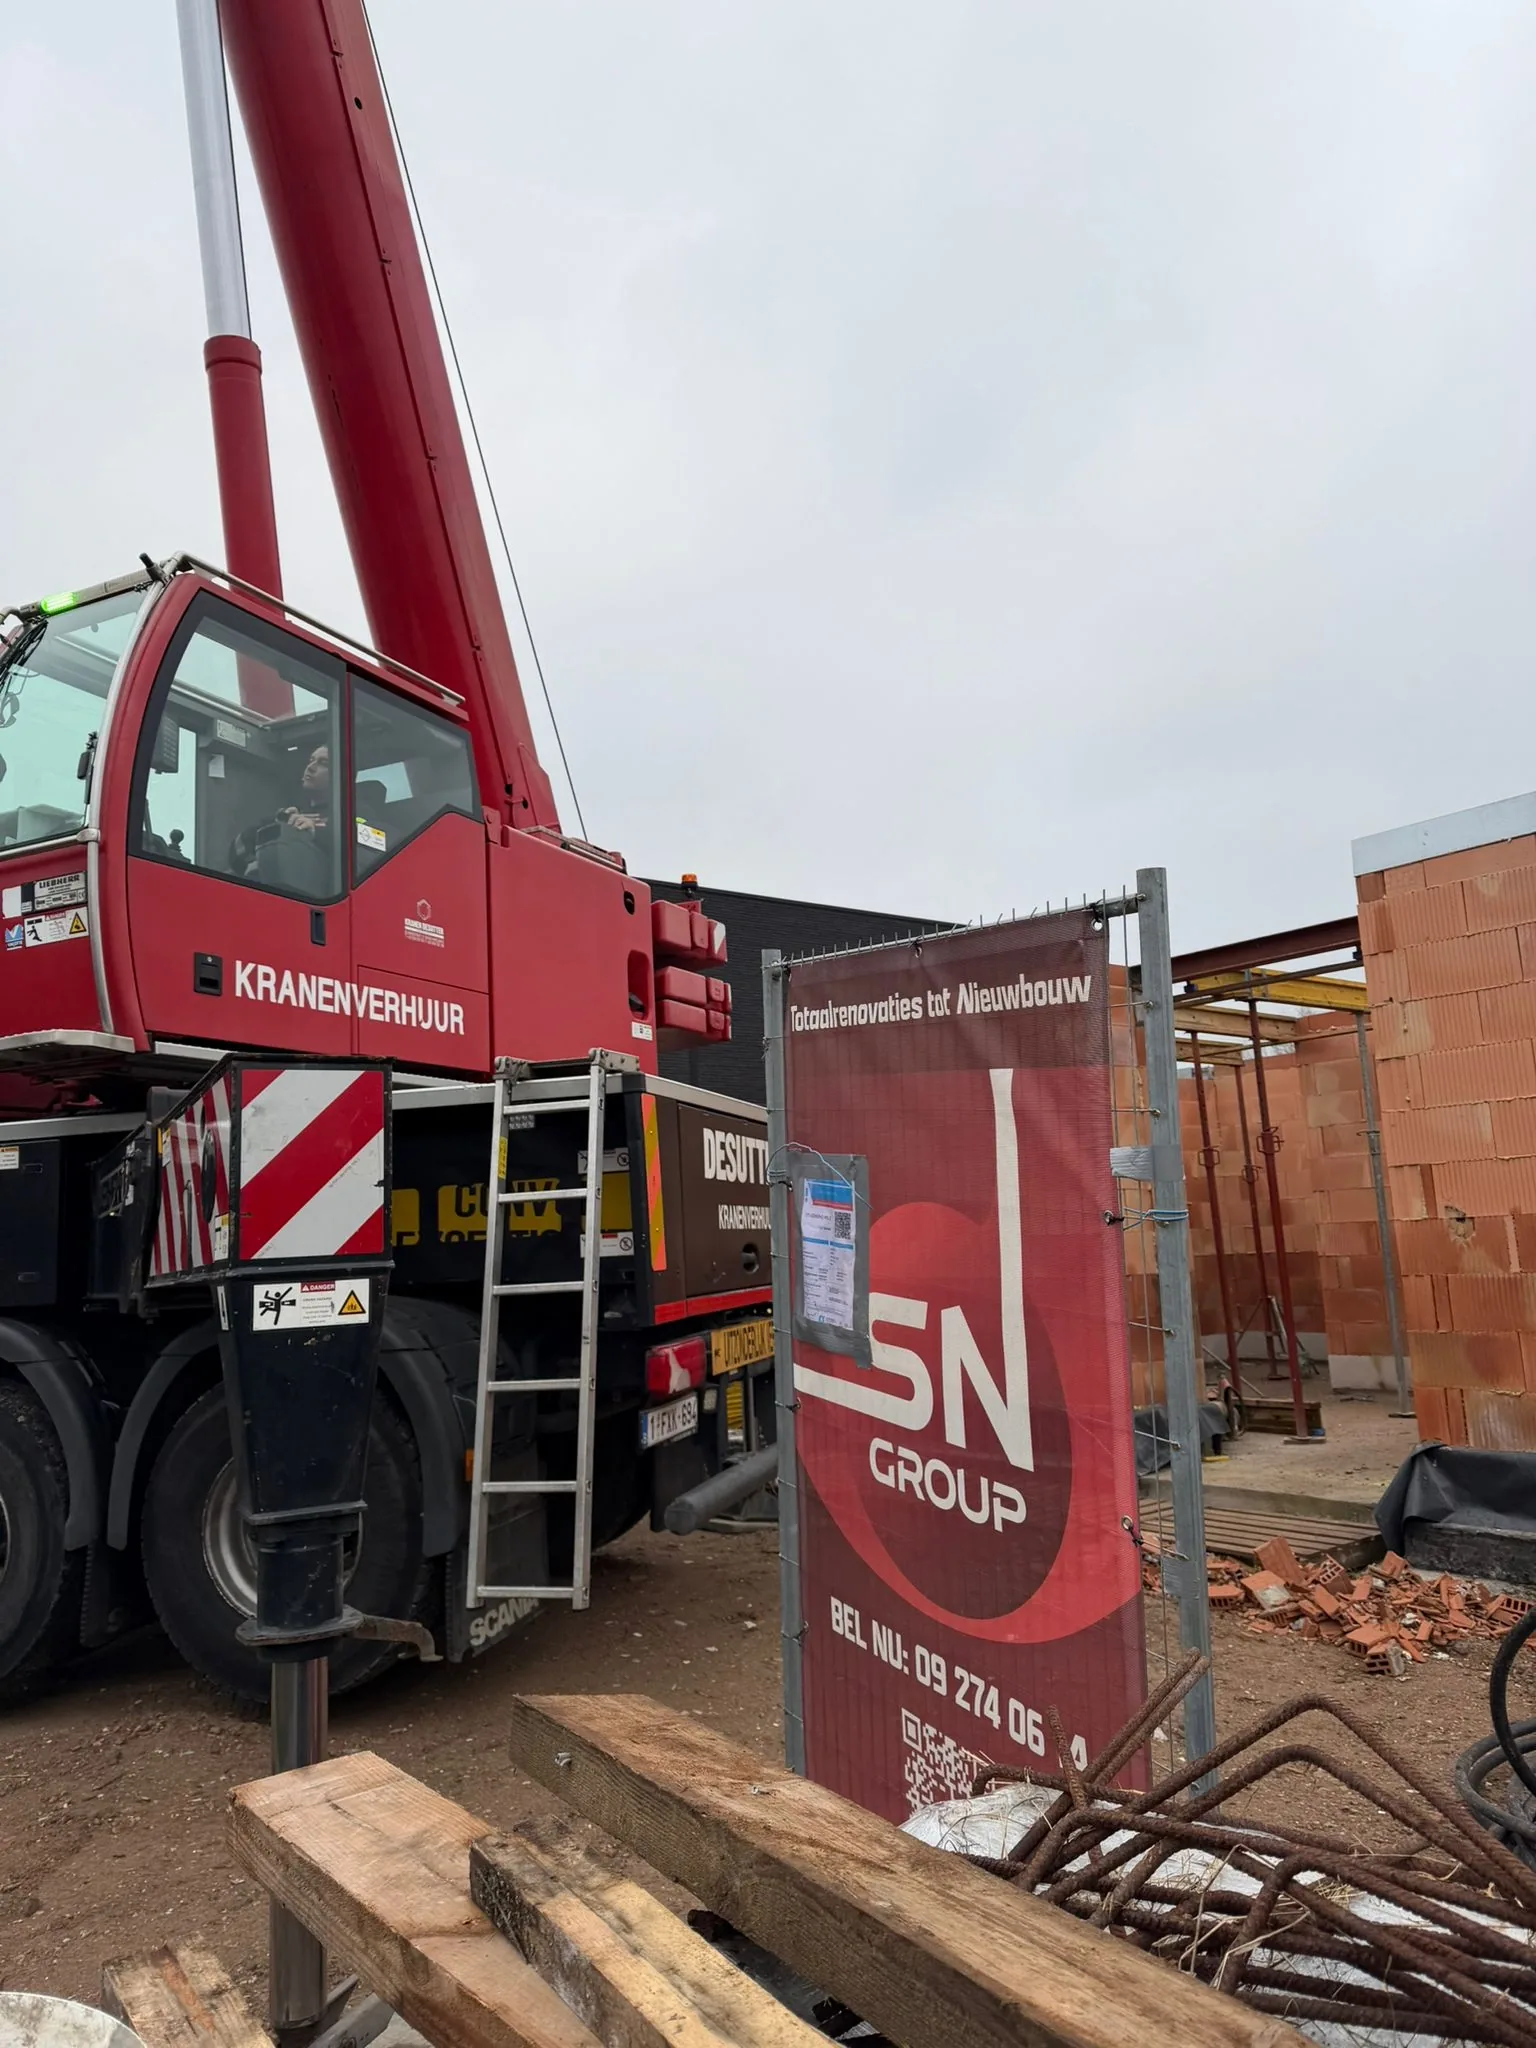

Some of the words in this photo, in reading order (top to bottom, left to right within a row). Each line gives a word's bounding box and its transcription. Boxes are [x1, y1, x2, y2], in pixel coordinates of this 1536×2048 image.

[39, 874, 81, 889] LIEBHERR
[235, 960, 465, 1036] KRANENVERHUUR
[791, 992, 923, 1032] Totaalrenovaties
[927, 987, 951, 1018] tot
[956, 973, 1092, 1015] Nieuwbouw
[309, 1282, 336, 1292] DANGER
[869, 1437, 1027, 1532] GROUP
[830, 1595, 868, 1650] BEL
[872, 1618, 909, 1675] NU:
[914, 1644, 947, 1696] 09
[954, 1665, 1001, 1729] 274
[1008, 1697, 1045, 1757] 06
